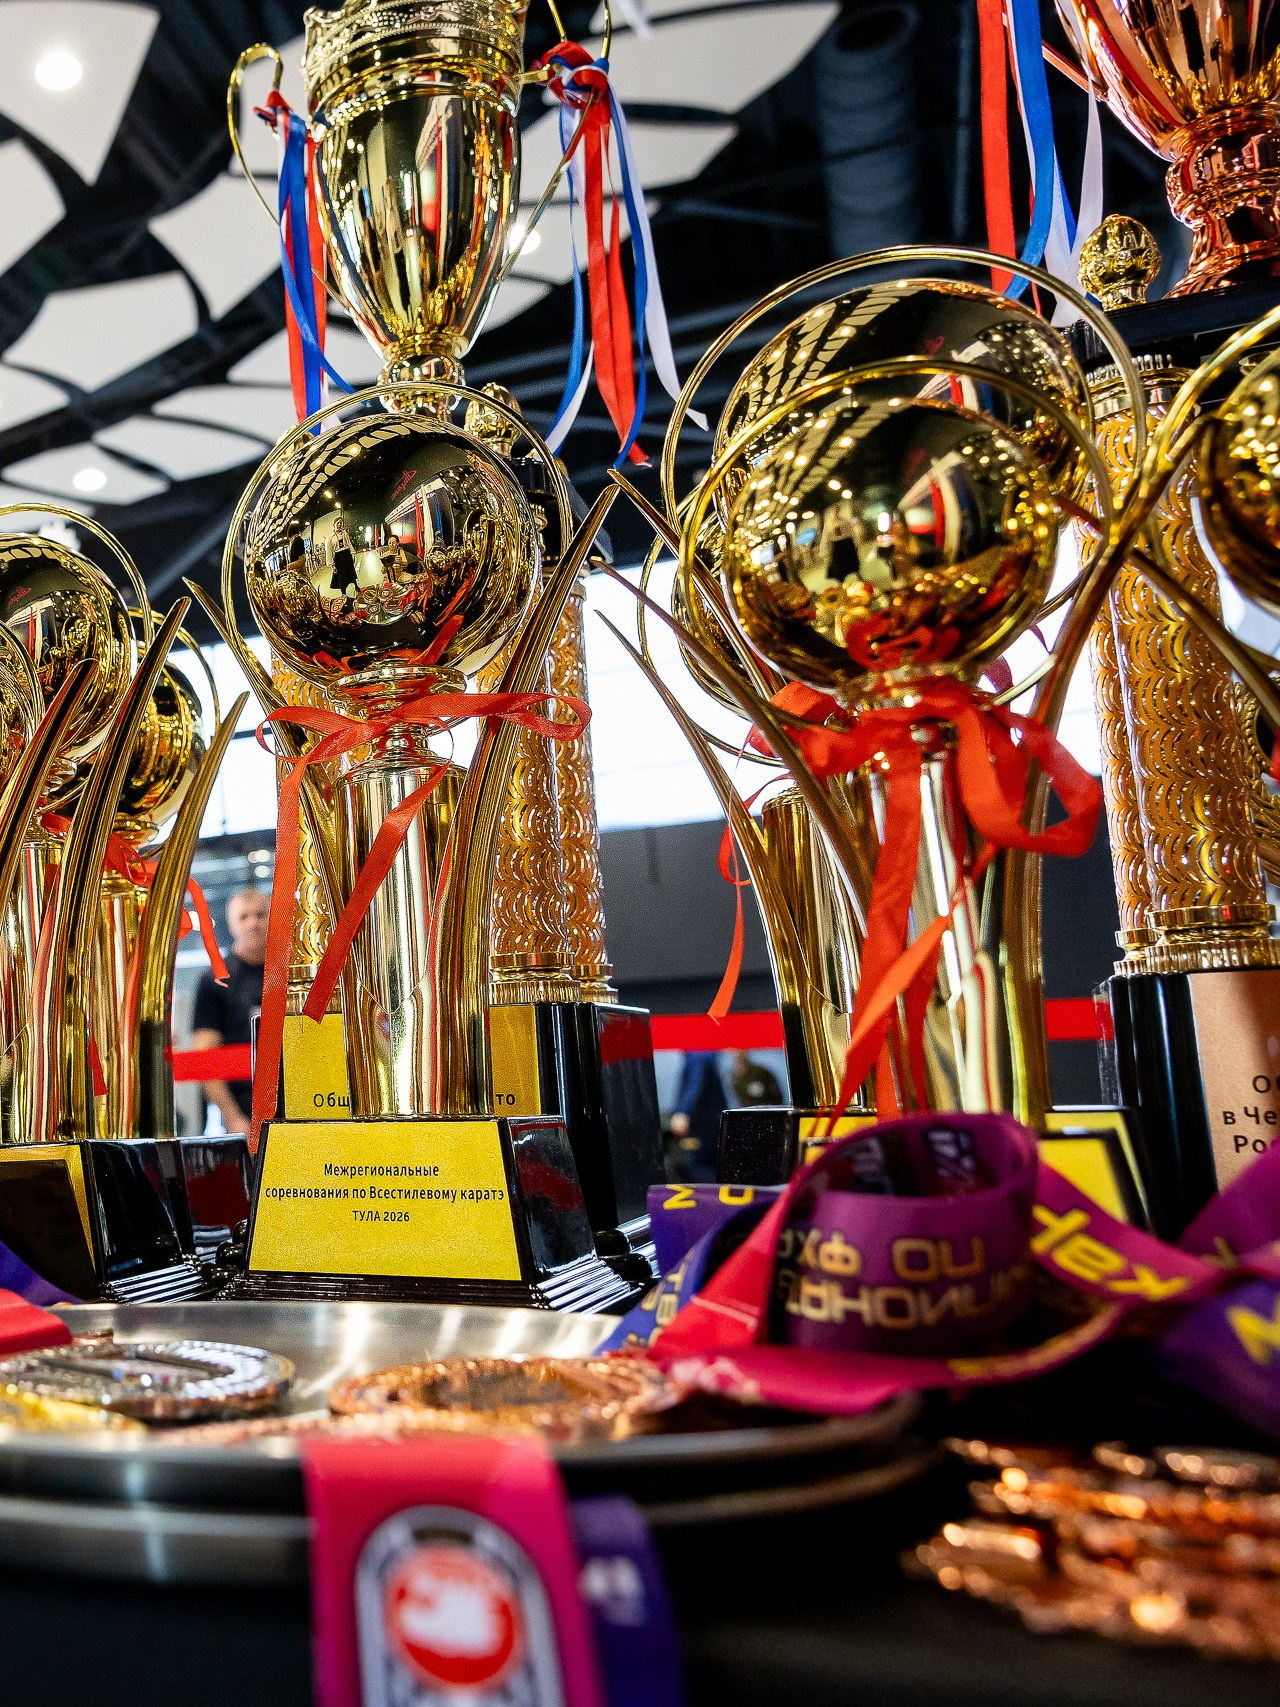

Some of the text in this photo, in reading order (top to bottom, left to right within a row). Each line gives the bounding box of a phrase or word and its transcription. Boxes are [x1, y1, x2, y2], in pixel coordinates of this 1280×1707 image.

[313, 1091, 516, 1107] Общ то
[1244, 1107, 1277, 1125] Че
[1234, 1135, 1268, 1153] Ро
[324, 1163, 439, 1179] Межрегиональные
[265, 1186, 504, 1203] соревнования по Всестилевому каратэ
[352, 1210, 410, 1222] ТУЛА 2026
